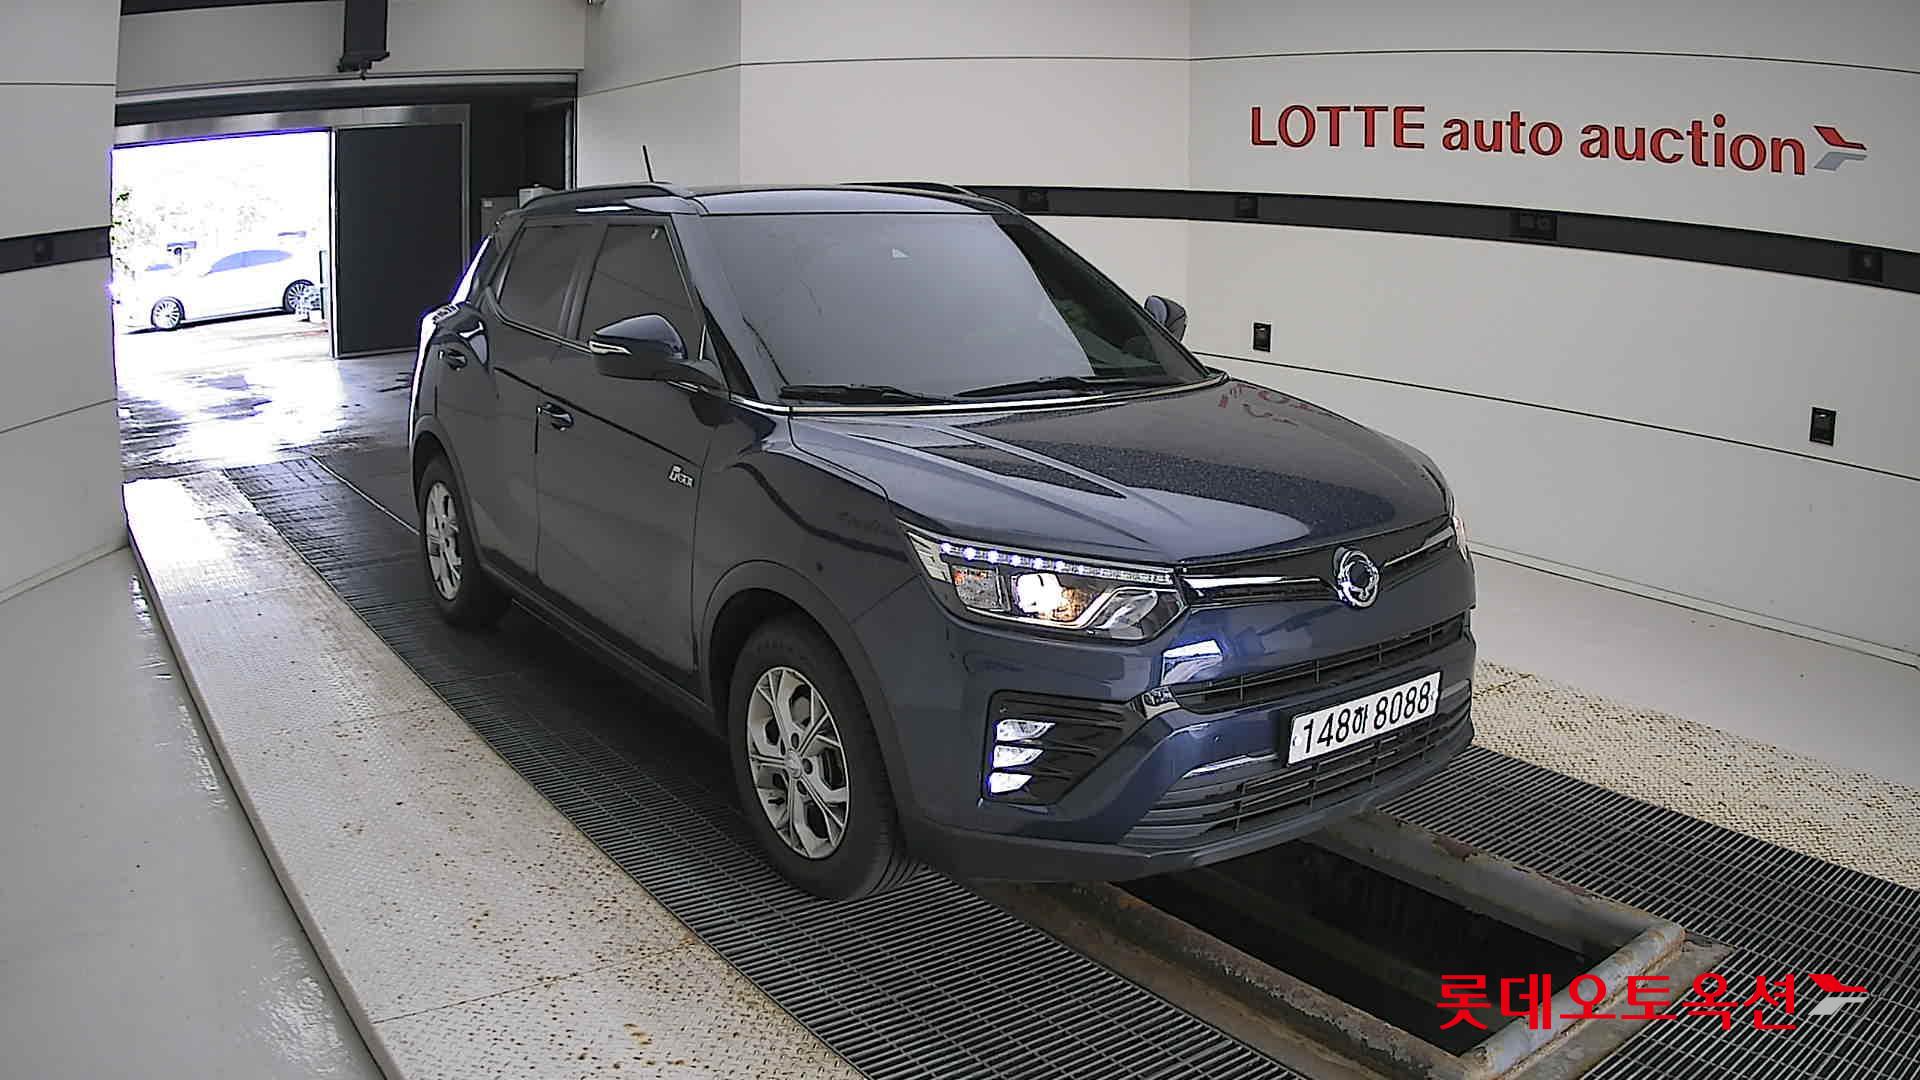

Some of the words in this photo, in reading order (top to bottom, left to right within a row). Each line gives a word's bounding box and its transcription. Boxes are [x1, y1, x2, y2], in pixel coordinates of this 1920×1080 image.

[1250, 105, 1425, 150] LOTTE
[1441, 110, 1564, 157] auto
[1578, 113, 1807, 176] auction
[1303, 704, 1369, 754] 148하
[1373, 681, 1432, 730] 8088
